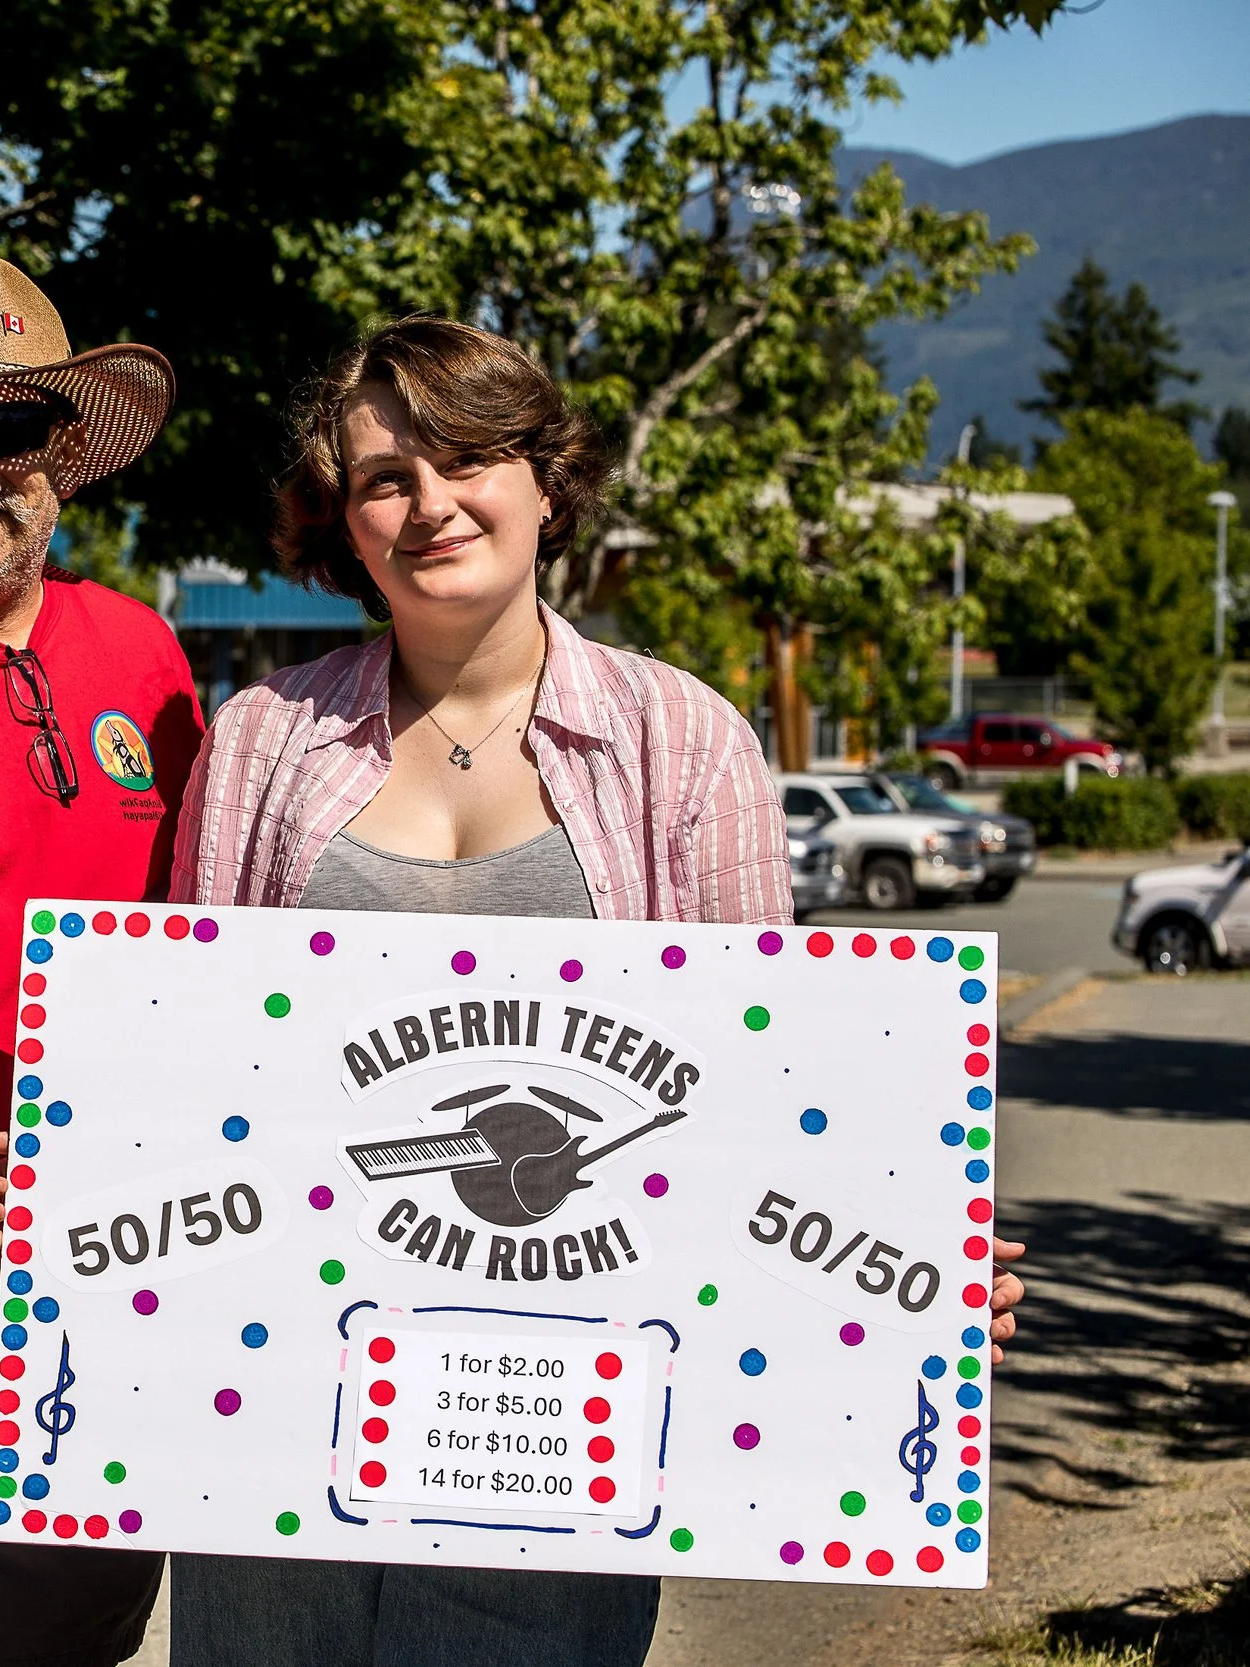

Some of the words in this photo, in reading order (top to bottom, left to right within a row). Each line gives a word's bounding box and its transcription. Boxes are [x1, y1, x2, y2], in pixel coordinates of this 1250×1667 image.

[343, 1000, 541, 1089] ALBERNI
[561, 1005, 701, 1106] TEENS
[67, 1183, 262, 1276] 50/50
[377, 1198, 476, 1272] CAN
[485, 1217, 639, 1282] ROCK!
[748, 1189, 941, 1313] 50/50
[440, 1353, 451, 1372] 1
[459, 1354, 492, 1374] for
[498, 1354, 565, 1378] $2.00
[437, 1391, 451, 1410] 3
[457, 1392, 490, 1412] for
[495, 1392, 562, 1417] $5.00
[427, 1429, 441, 1448] 6
[447, 1430, 480, 1450] for
[486, 1430, 568, 1456] $10.00
[418, 1468, 446, 1488] 14
[452, 1469, 485, 1490] for
[490, 1470, 573, 1496] $20.00
